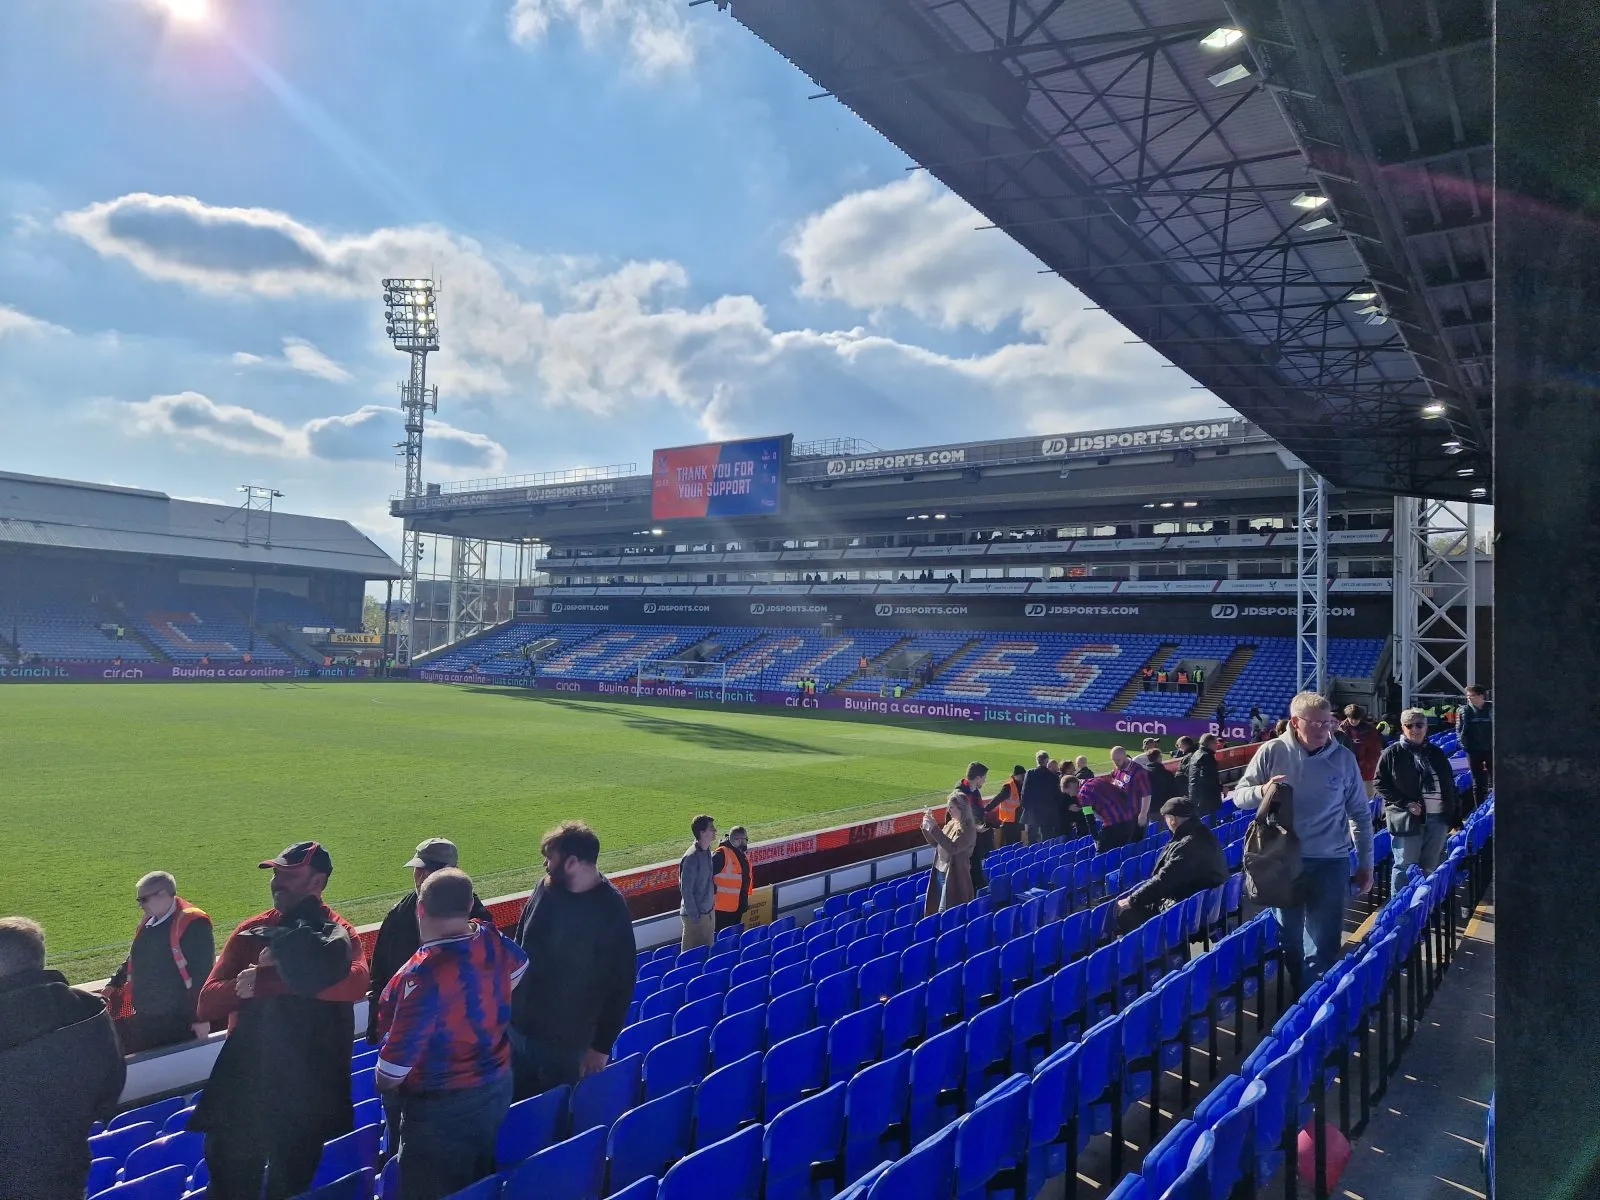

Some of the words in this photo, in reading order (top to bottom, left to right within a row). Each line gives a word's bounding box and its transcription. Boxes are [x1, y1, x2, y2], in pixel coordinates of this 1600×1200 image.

[1069, 422, 1229, 453] JDSPORTS.COM
[847, 449, 965, 473] JDSPORTS.COM
[677, 465, 708, 481] THANK
[711, 462, 731, 478] YOU
[734, 460, 754, 476] FOR
[679, 482, 703, 498] YOUR
[707, 478, 751, 497] SUPPORT
[563, 604, 608, 612] JDSPORTS.COM
[657, 604, 710, 612] JDSPORTS.COM
[766, 604, 828, 613] JDSPORTS.COM
[894, 606, 968, 615] JDSPORTS.COM
[1048, 606, 1139, 616] JDSPORTS.COM
[336, 634, 375, 642] STANLEY
[10, 666, 50, 676] cinch
[54, 666, 68, 676] it.
[103, 668, 143, 678] cinch
[172, 667, 216, 678] Buying
[218, 668, 226, 677] a
[228, 668, 248, 677] car
[250, 668, 284, 677] online
[294, 667, 310, 678] jus
[420, 670, 444, 682] Buying
[444, 673, 450, 681] a
[450, 674, 462, 682] car
[462, 672, 486, 684] online
[492, 675, 507, 686] just
[508, 676, 528, 687] cinch
[556, 682, 581, 692] cinch
[599, 682, 628, 695] Buying
[630, 686, 636, 694] a
[640, 686, 654, 695] car
[657, 685, 686, 697] online
[696, 688, 714, 700] just
[716, 690, 742, 702] cnch
[746, 690, 756, 702] it.
[844, 698, 888, 714] Buying
[890, 702, 900, 712] a
[903, 704, 924, 714] car
[928, 704, 970, 718] online
[984, 706, 1012, 721] just
[1015, 708, 1055, 724] cinch
[1060, 712, 1076, 726] it.
[1116, 720, 1166, 735] cinch
[750, 845, 785, 863] ASSOCIATE
[786, 839, 814, 854] PARTNER
